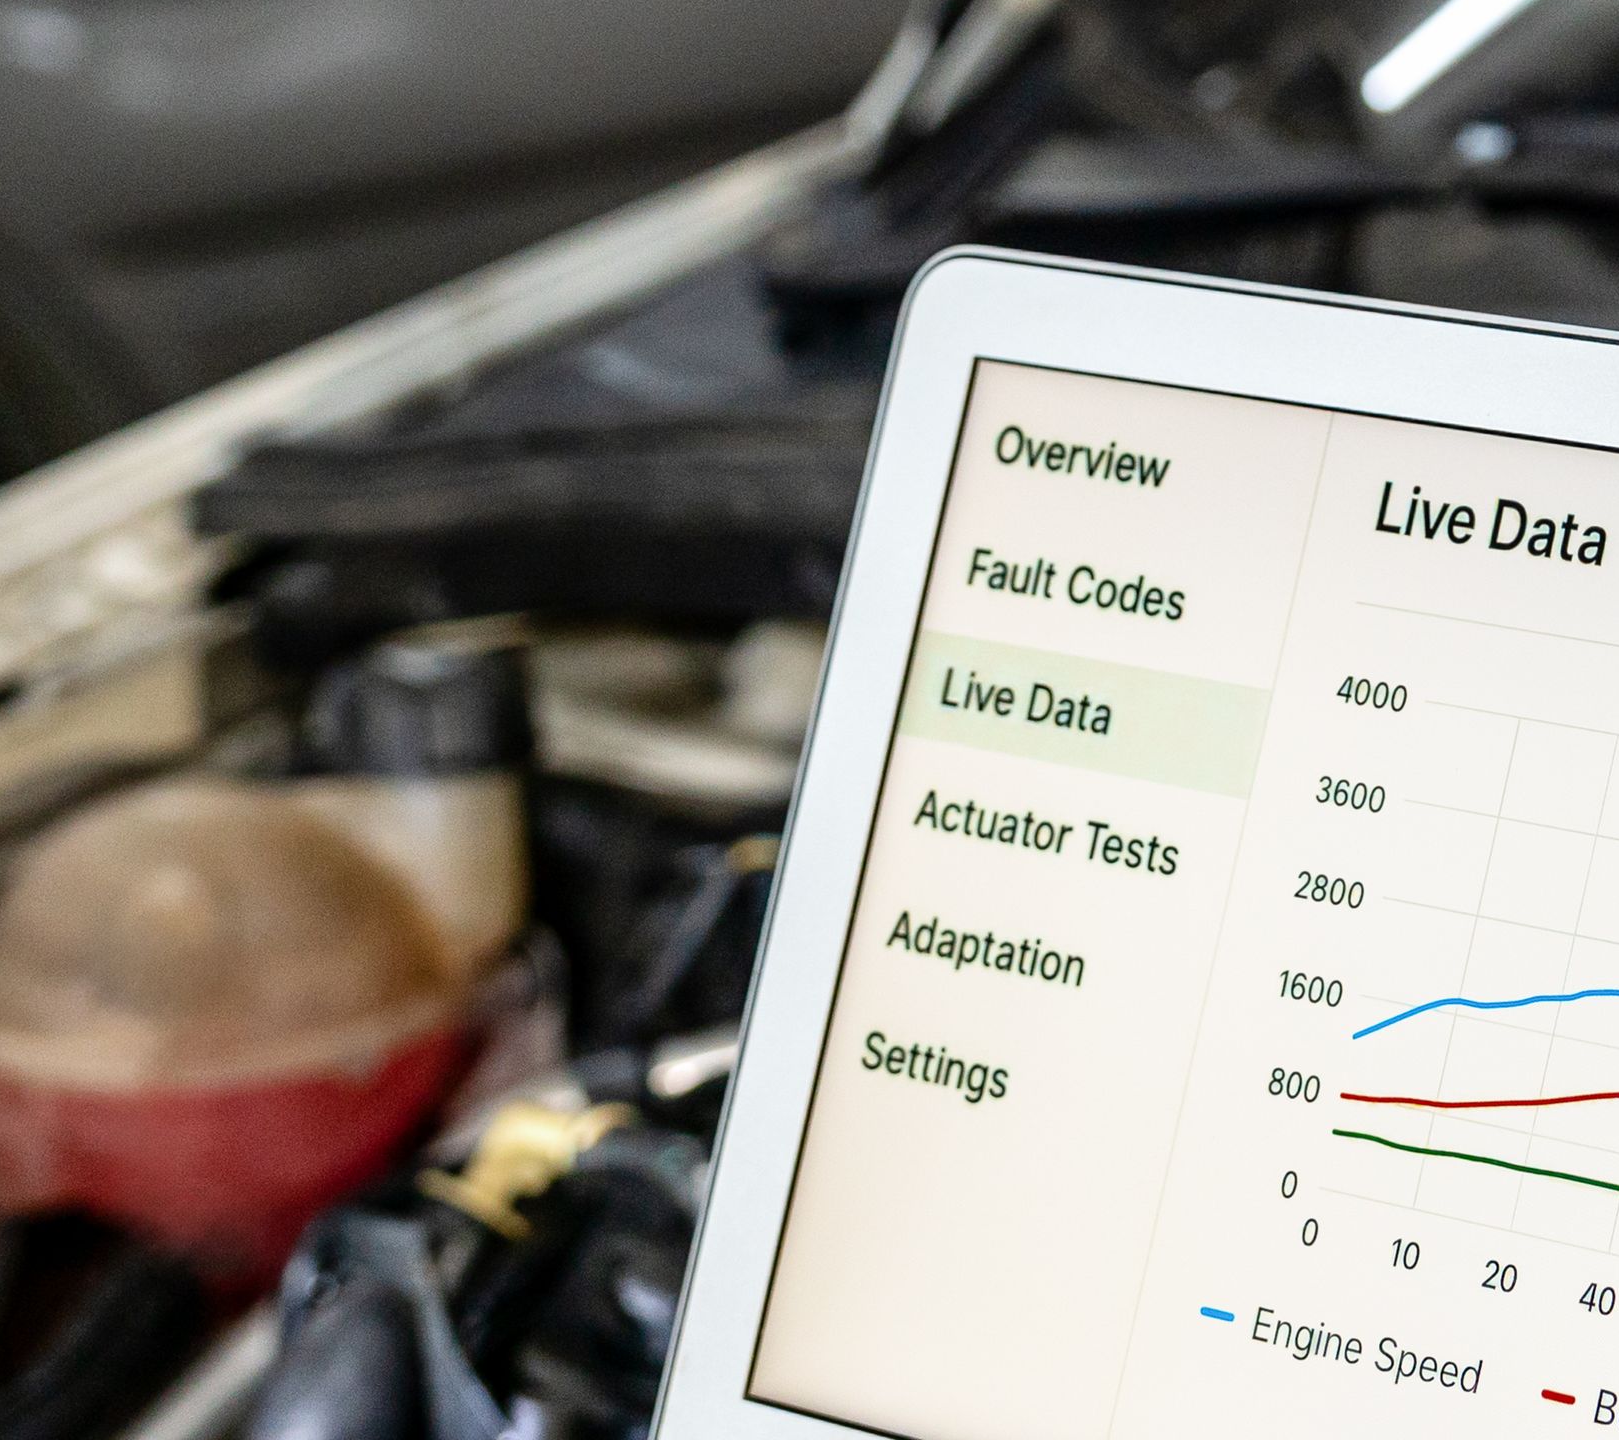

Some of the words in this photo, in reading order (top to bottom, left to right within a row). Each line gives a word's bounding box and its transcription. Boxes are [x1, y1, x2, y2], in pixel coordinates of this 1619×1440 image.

[993, 423, 1173, 490] Overview
[1373, 479, 1478, 546] Live
[1486, 496, 1608, 568] Data
[965, 546, 1058, 601] Fault
[1065, 563, 1187, 623] Codes
[938, 665, 1017, 719] Live
[1024, 681, 1113, 737] Data
[1334, 674, 1409, 714] 4000
[1314, 774, 1387, 815] 3600
[912, 788, 1075, 855] Actuator
[1085, 818, 1181, 877] Tests
[1292, 869, 1366, 911] 2800
[884, 909, 1086, 989] Adaptation
[1278, 968, 1345, 1009] 1600
[860, 1029, 1010, 1106] Settings
[1266, 1065, 1322, 1105] 800
[1279, 1169, 1300, 1201] 0
[1300, 1216, 1320, 1248] 0
[1391, 1237, 1422, 1272] 10
[1479, 1258, 1519, 1294] 20
[1577, 1281, 1618, 1317] 40
[1250, 1305, 1364, 1366] Engine
[1373, 1335, 1485, 1396] Speed
